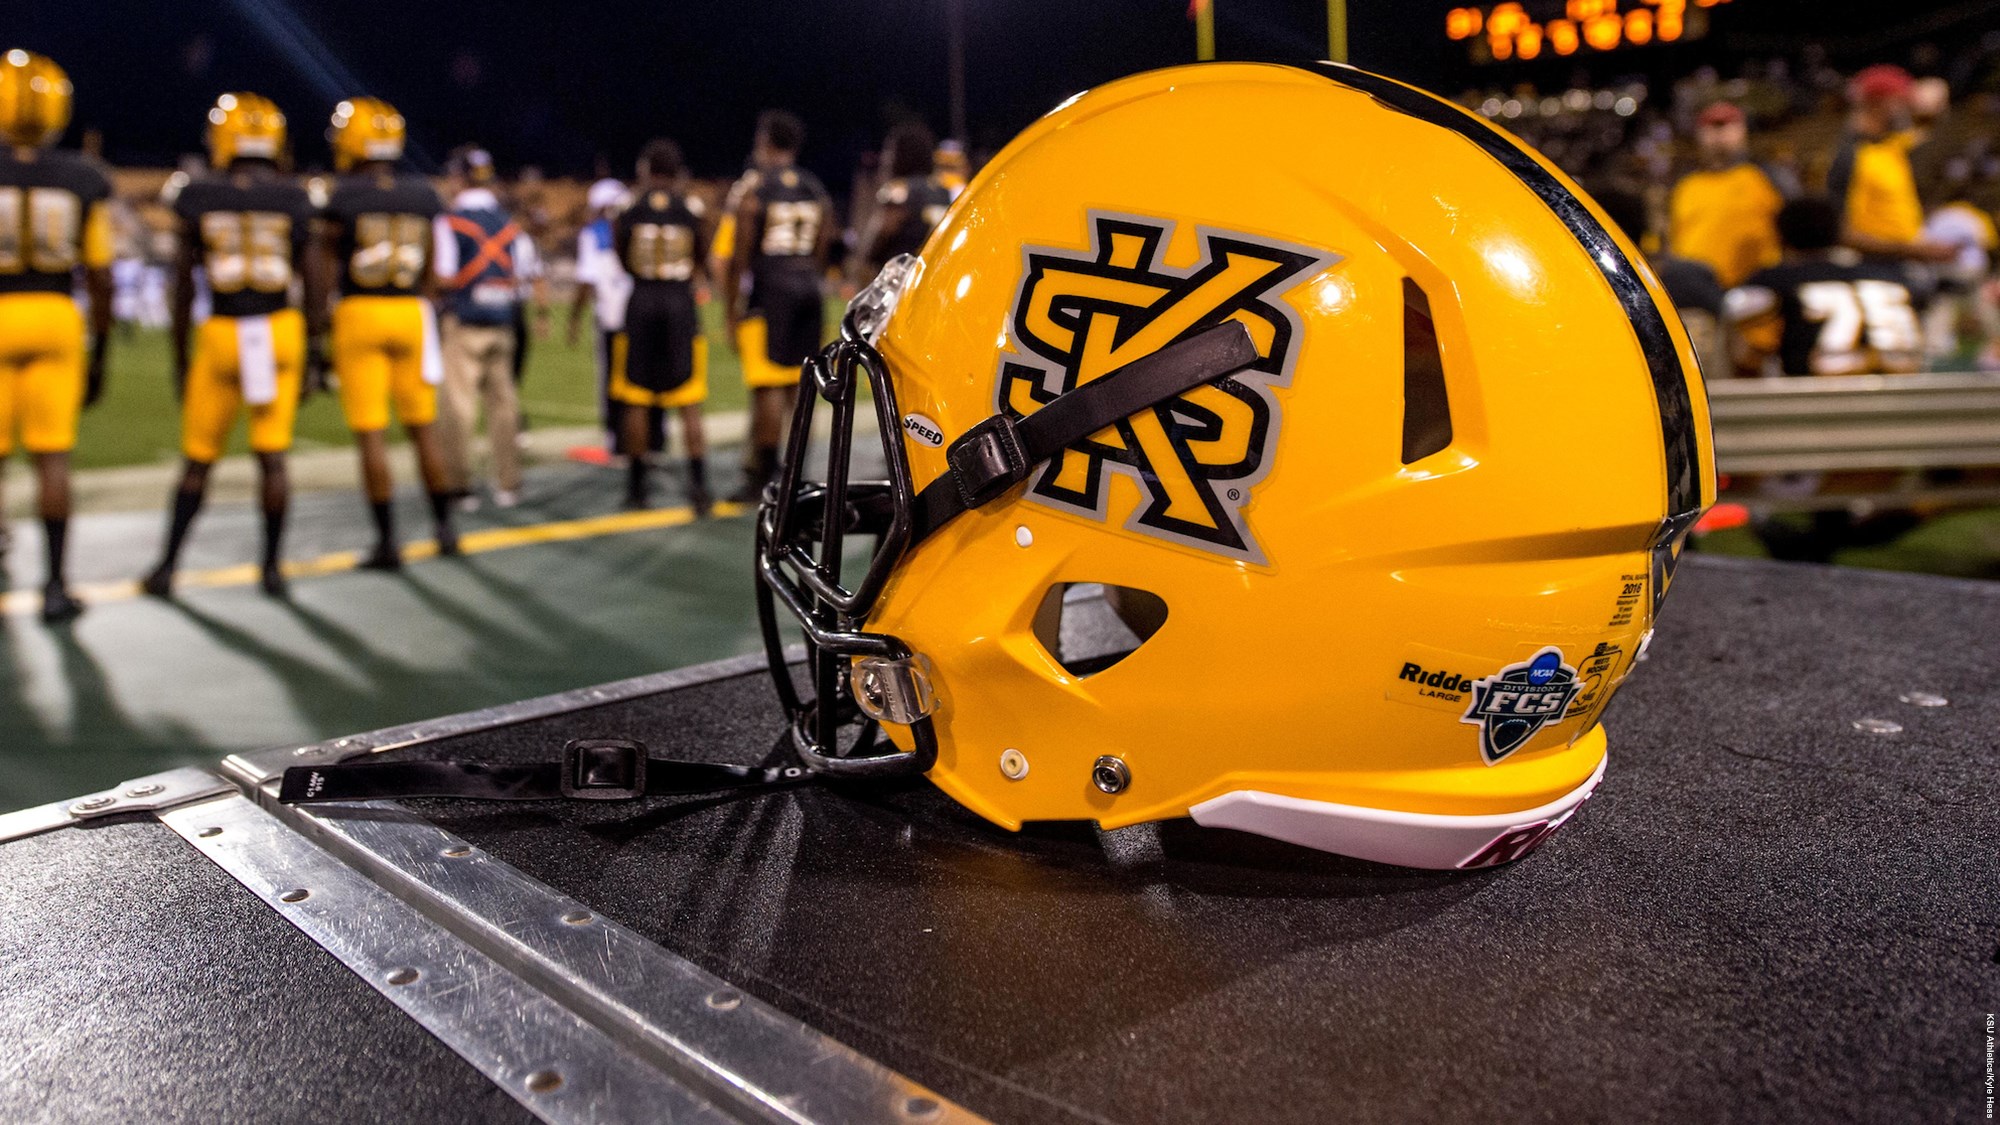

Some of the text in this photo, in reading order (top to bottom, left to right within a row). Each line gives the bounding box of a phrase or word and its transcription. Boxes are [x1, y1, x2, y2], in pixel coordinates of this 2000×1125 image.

[1799, 279, 1922, 375] 75
[903, 416, 943, 445] SPEED
[1622, 583, 1642, 594] 2016
[1531, 669, 1555, 677] NCAA
[1418, 688, 1461, 702] LARGE
[1485, 691, 1564, 713] FCS
